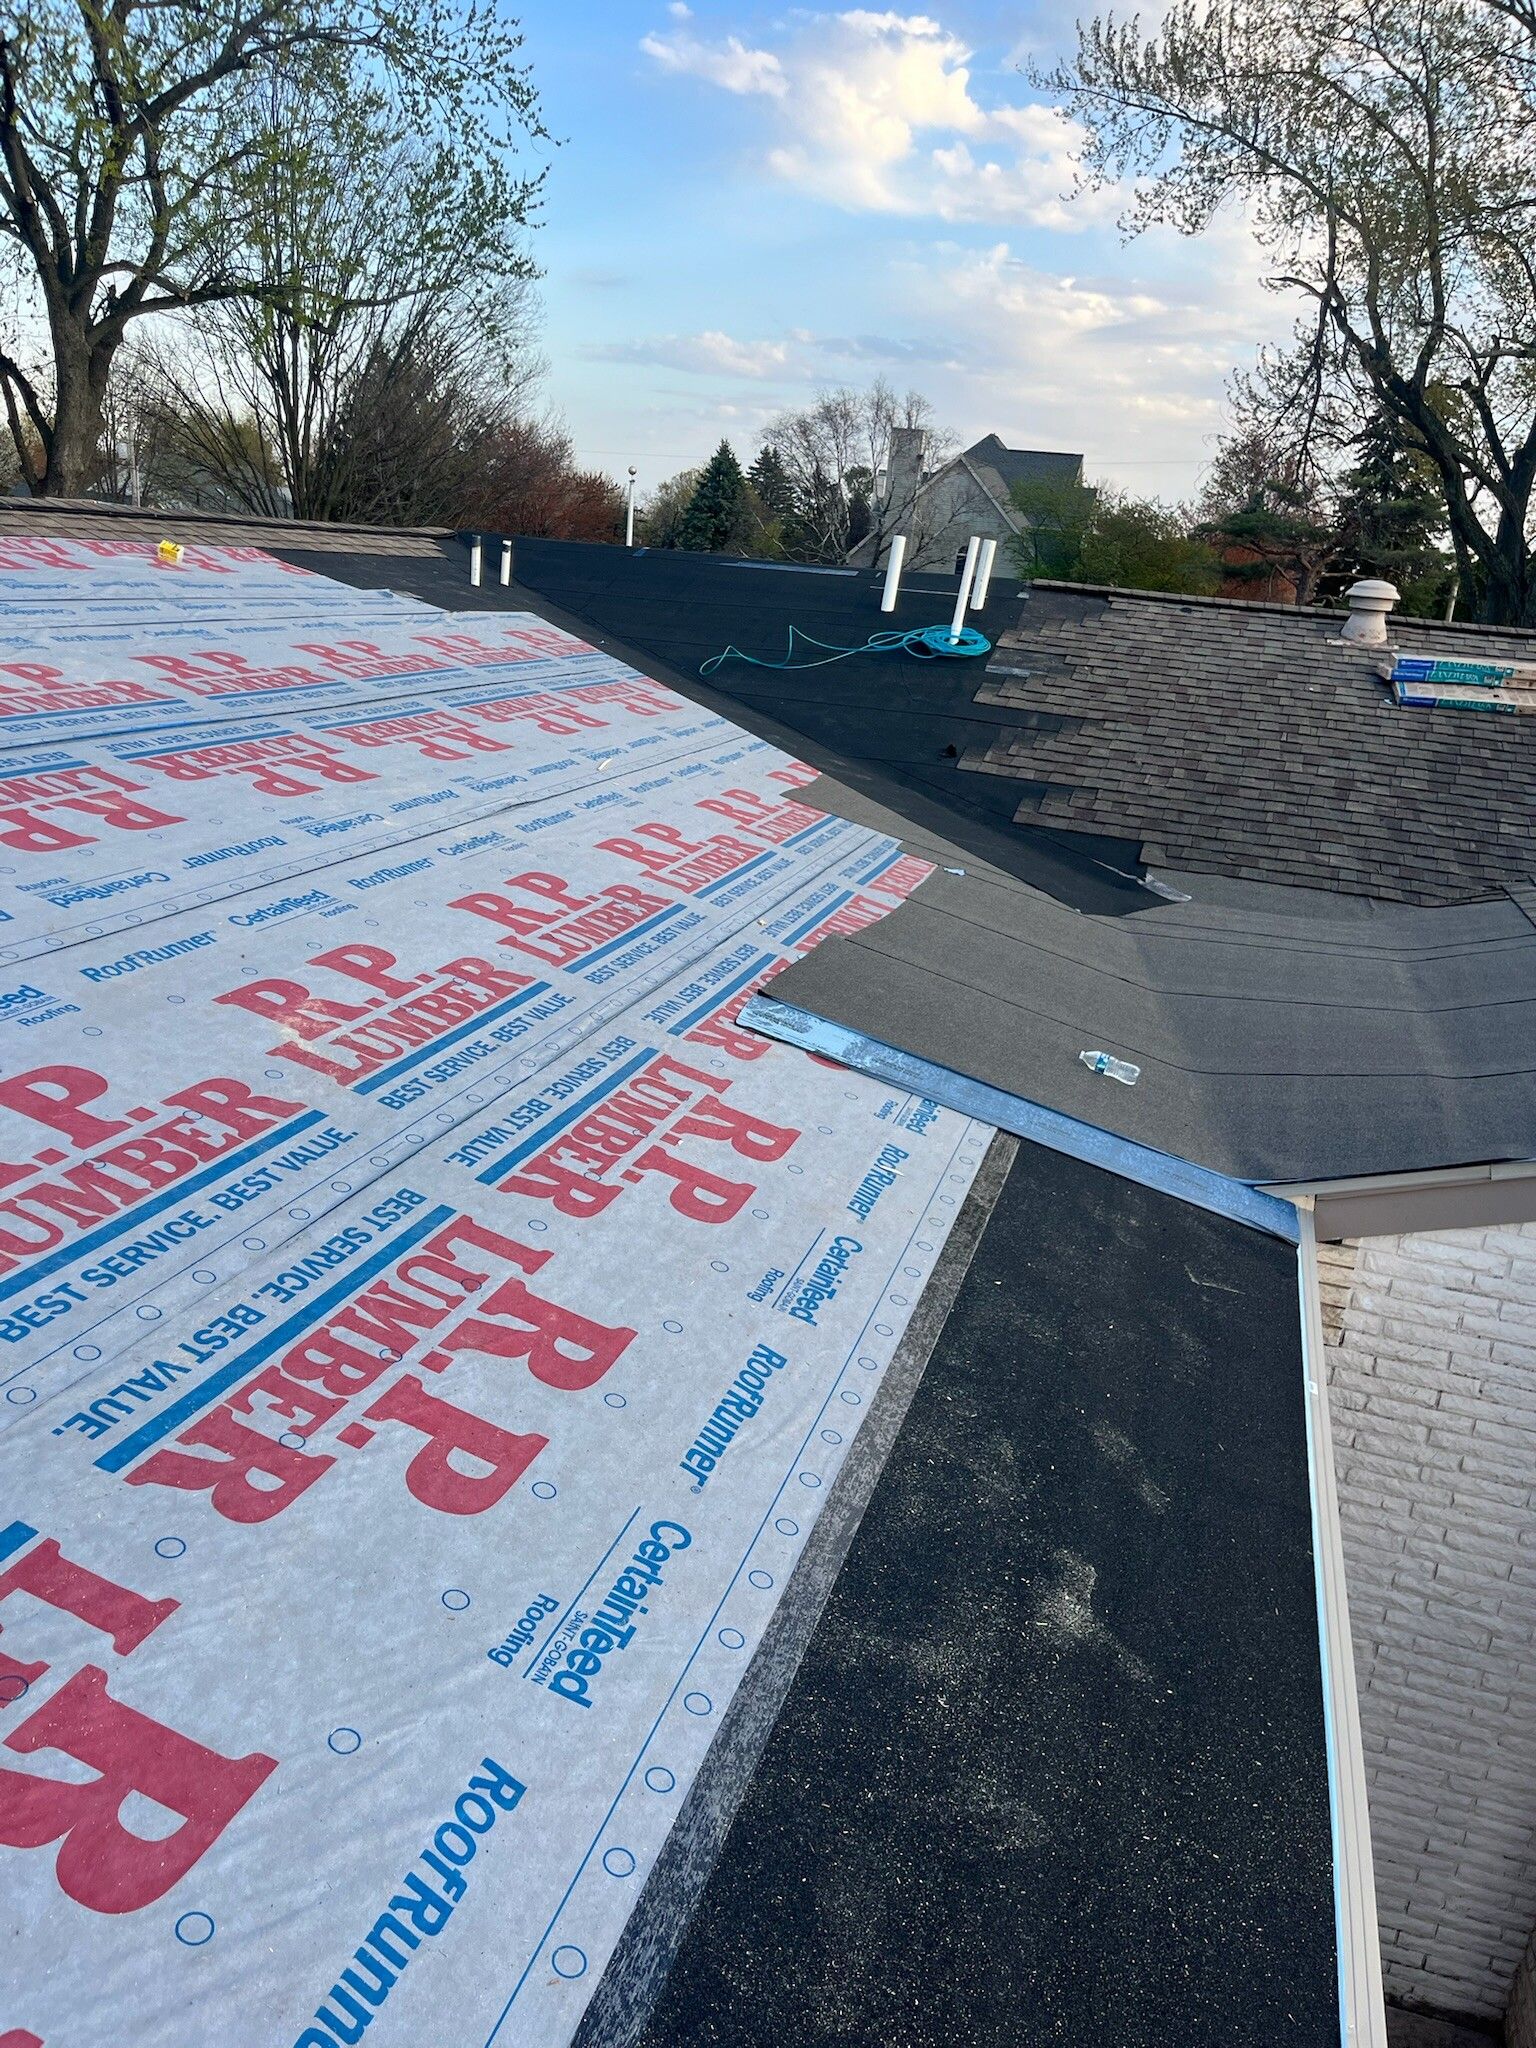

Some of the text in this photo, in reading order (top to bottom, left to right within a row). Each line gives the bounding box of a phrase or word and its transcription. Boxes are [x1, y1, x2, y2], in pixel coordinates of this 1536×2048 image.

[128, 651, 271, 680] R.P.
[156, 666, 337, 696] LUMBER
[288, 640, 400, 664] R.P.
[1, 720, 48, 733] BEST
[29, 751, 74, 764] BEST
[126, 734, 344, 780] LUMBER
[321, 711, 480, 747] LUMBER
[393, 727, 514, 761] R.P.
[223, 753, 382, 797] R.P.
[694, 788, 787, 829] R.P.
[47, 835, 288, 909] RoofRunner CertainTeed
[593, 823, 708, 872] R.P.
[638, 834, 767, 894] LUMBER
[15, 877, 70, 893] Roofing
[80, 930, 217, 983] RoofRunner
[227, 889, 330, 927] CertainTeed
[348, 857, 436, 891] RoofRunner
[320, 903, 359, 918] Roofing
[446, 871, 600, 936] R.P.
[710, 892, 734, 908] BEST
[496, 884, 675, 967] LUMBER
[583, 911, 708, 985] BEST SERVICE. BEST VALUE.
[17, 1003, 81, 1027] Roofing
[211, 943, 436, 1041] R.P.
[641, 943, 760, 1024] BEST SERVICE. BEST VALUE.
[265, 957, 537, 1087] LUMBER
[377, 992, 577, 1110] BEST SERVICE. BEST VALUE.
[444, 1035, 637, 1168] BEST SERVICE. BEST VALUE.
[496, 1054, 734, 1218] LUMBER
[619, 1094, 802, 1225] R.P.
[847, 1143, 910, 1221] RoofRunner
[0, 1127, 359, 1343] BEST SERVICE. BEST VALUE.
[51, 1187, 428, 1440] BEST SERVICE. BEST VALUE.
[747, 1267, 785, 1302] Roofing
[788, 1235, 864, 1327] CertainTeed
[122, 1214, 555, 1524] LUMBER
[336, 1278, 638, 1515] R.P.
[679, 1343, 788, 1489] RoofRunner
[488, 1593, 560, 1668] Roofing
[532, 1610, 587, 1685] SAINT-GOBAIN
[548, 1520, 692, 1709] CertainTeed
[293, 1757, 527, 2048] RoofRunn
